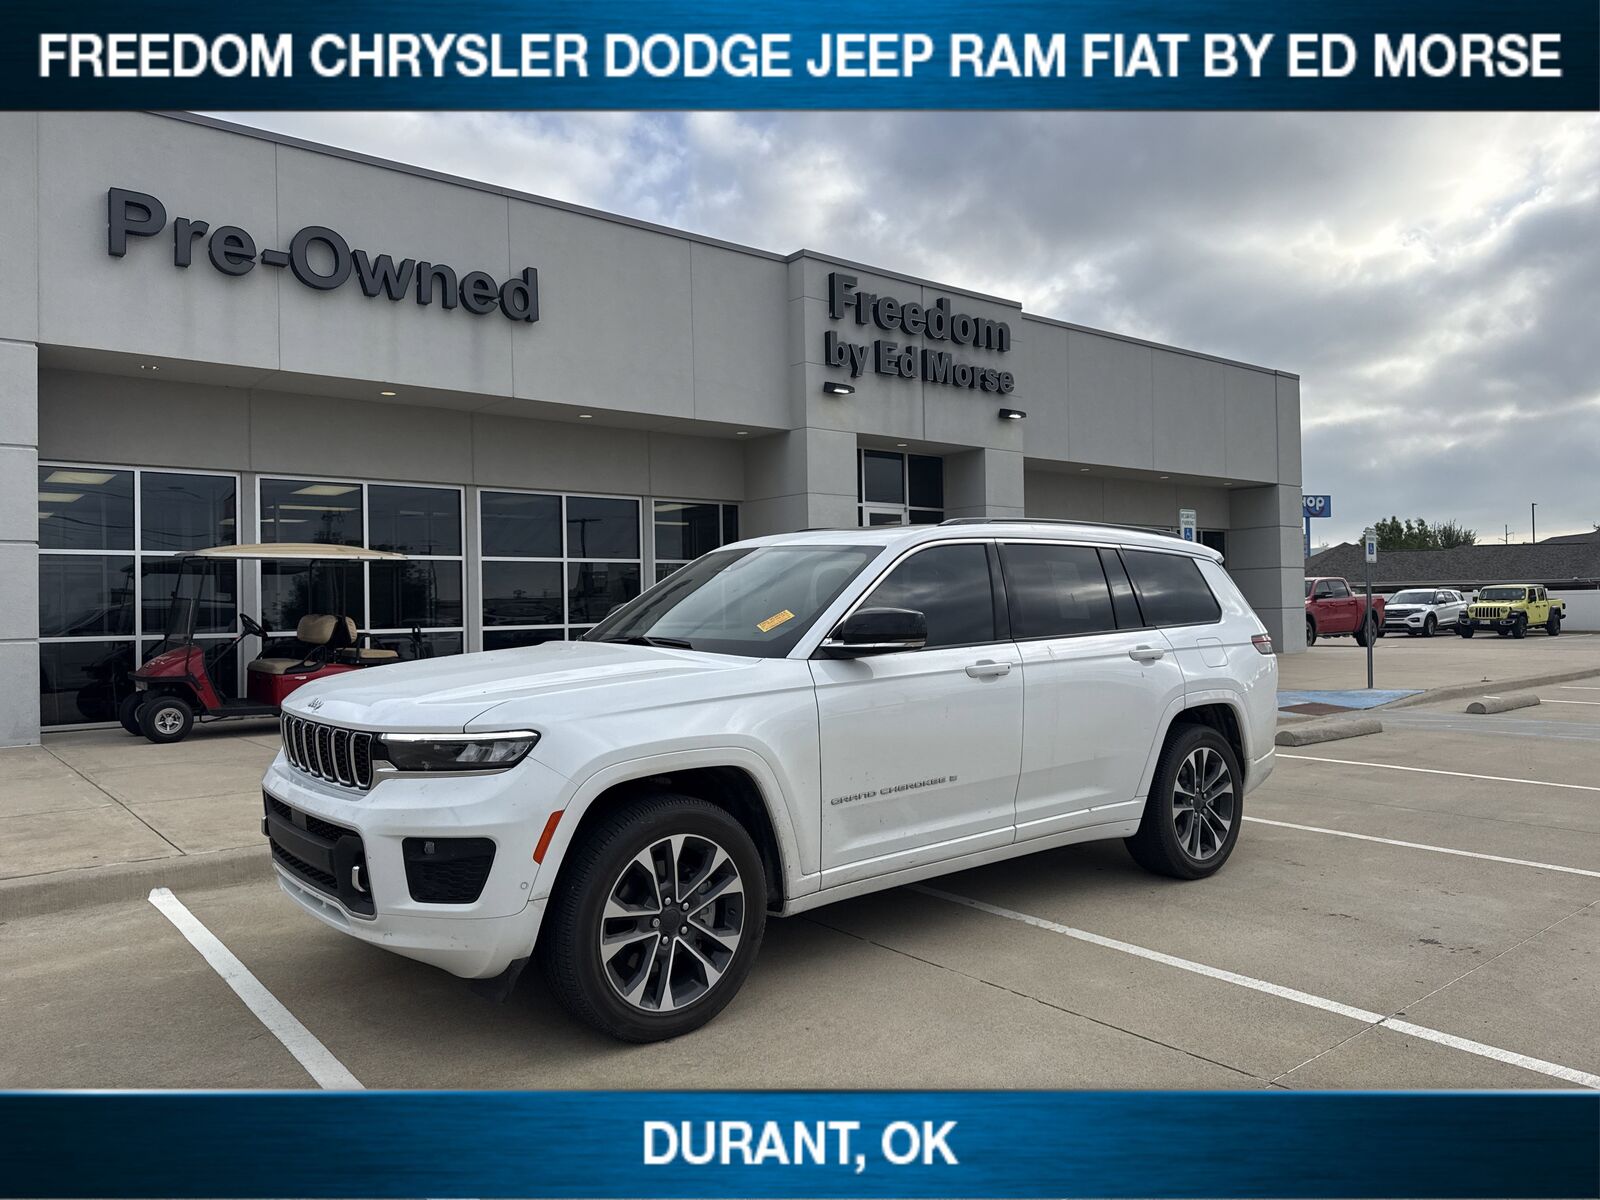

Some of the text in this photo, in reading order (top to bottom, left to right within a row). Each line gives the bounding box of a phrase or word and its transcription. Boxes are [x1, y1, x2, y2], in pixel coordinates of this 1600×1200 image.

[107, 187, 540, 323] Pre-Owned
[828, 272, 1010, 351] Freedom
[825, 330, 1015, 394] by Ed Morse
